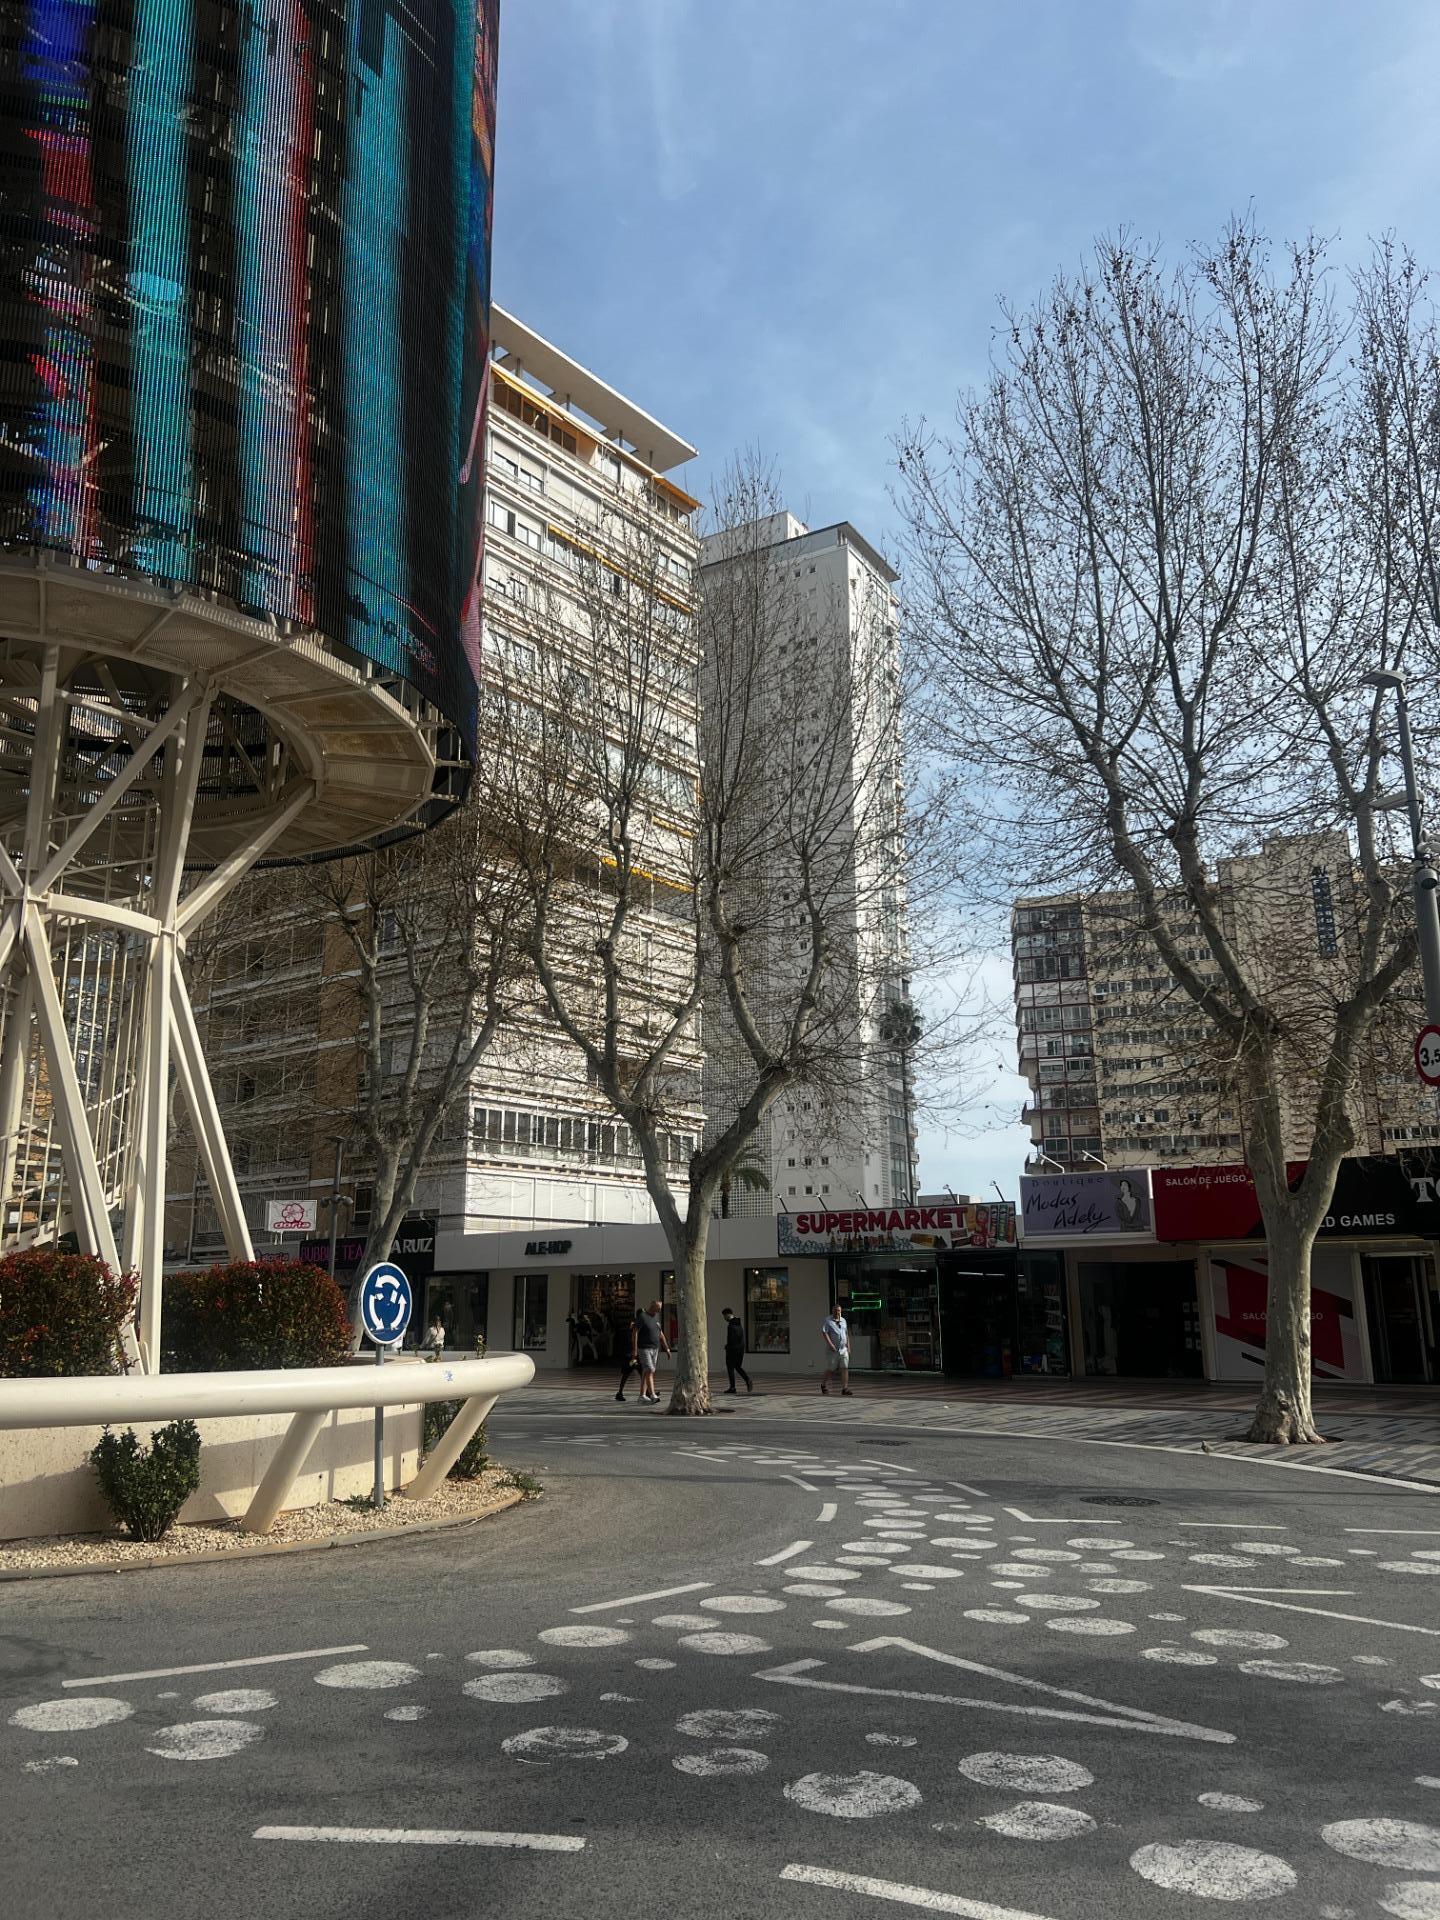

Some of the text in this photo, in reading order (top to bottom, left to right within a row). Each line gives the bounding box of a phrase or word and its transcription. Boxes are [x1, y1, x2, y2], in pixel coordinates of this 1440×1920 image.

[1165, 1174, 1247, 1187] SALÓN DE JUEGO
[1409, 1176, 1440, 1203] T
[1026, 1190, 1080, 1215] Modas
[274, 1221, 311, 1229] doria
[796, 1207, 968, 1234] SUPERMARKET
[1054, 1203, 1111, 1233] Adely
[1340, 1213, 1396, 1227] GAMES
[343, 1244, 363, 1260] TEA
[403, 1237, 434, 1254] RUIZ
[525, 1239, 572, 1255] ALE-HOP
[1242, 1310, 1267, 1320] SALÓ
